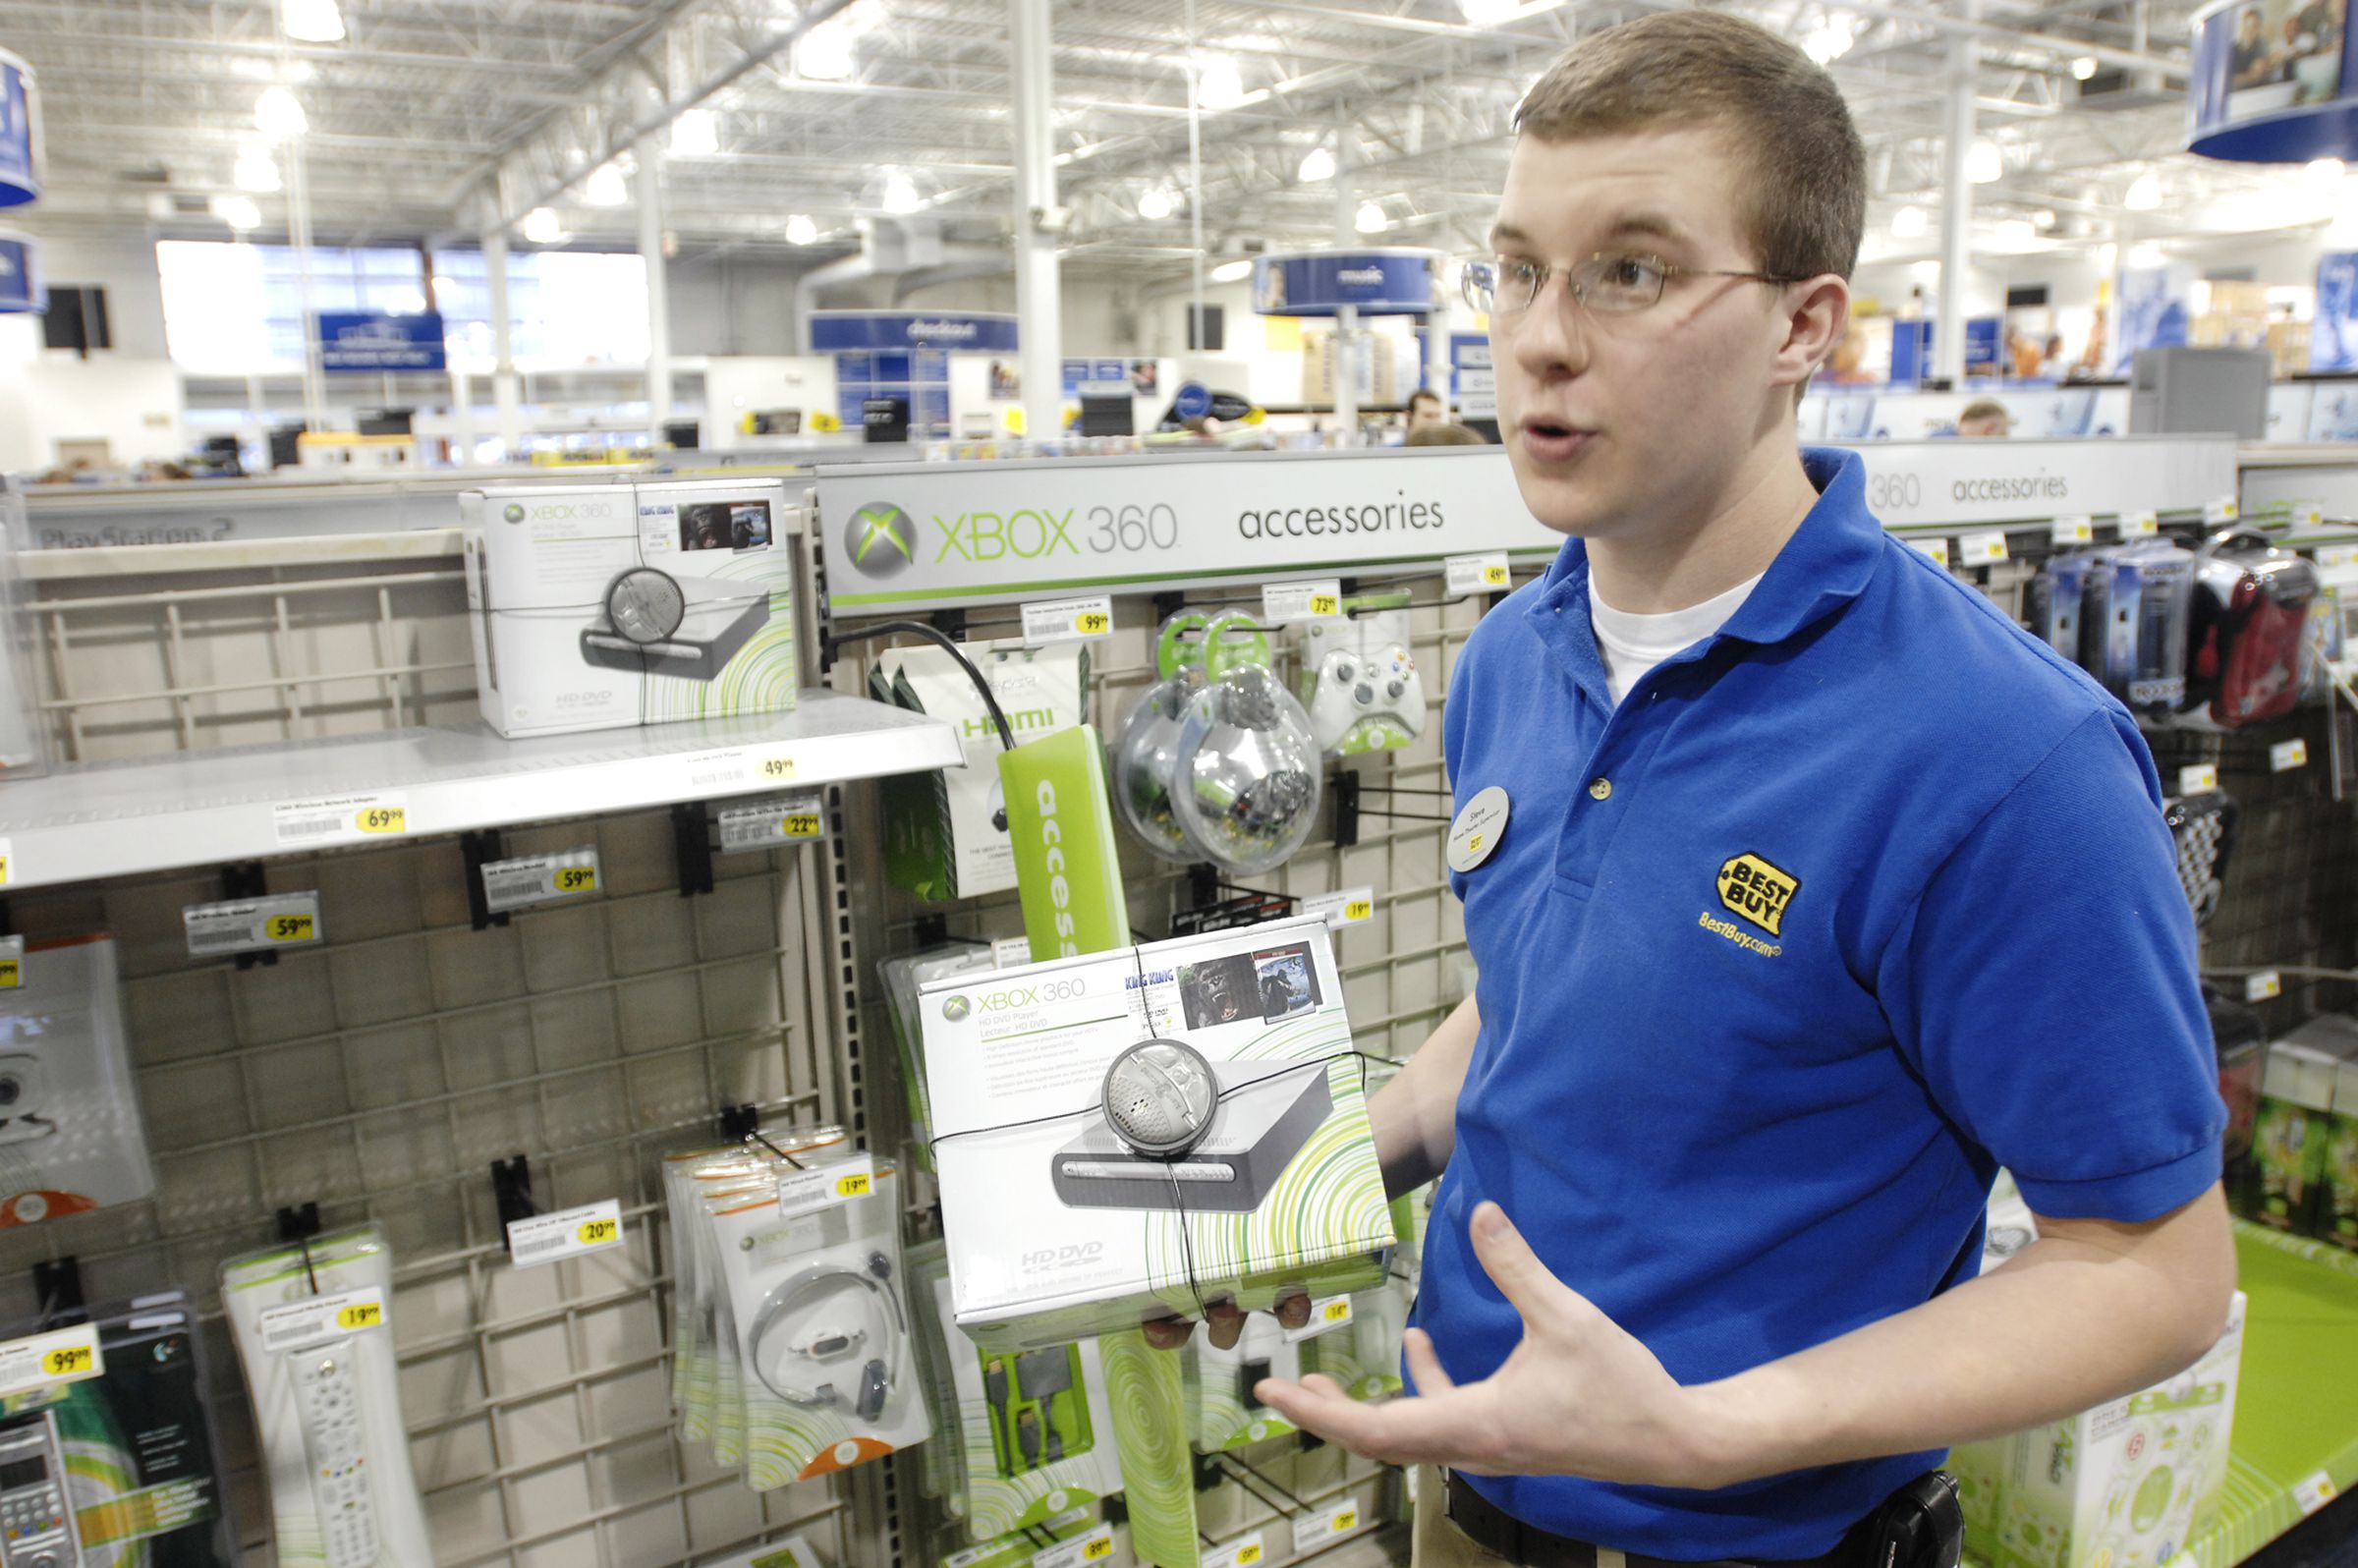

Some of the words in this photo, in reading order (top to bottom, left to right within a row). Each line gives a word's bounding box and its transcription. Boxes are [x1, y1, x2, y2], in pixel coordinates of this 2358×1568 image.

[1871, 473, 1920, 509] 360
[1952, 466, 2067, 502] accessories
[531, 504, 578, 520] XBOX
[580, 503, 611, 518] 360
[931, 508, 1080, 563] XBOX
[1088, 503, 1178, 553] 360
[1239, 489, 1444, 539] accessories
[1732, 862, 1790, 904] BEST
[1725, 882, 1779, 922] BUY
[978, 985, 1040, 1015] XBOX
[1043, 979, 1086, 1002] 360
[979, 1017, 992, 1028] HD
[994, 1013, 1011, 1025] DVD
[1013, 1010, 1039, 1023] Player
[980, 1025, 1012, 1038] Lecteur
[1015, 1021, 1030, 1033] HD
[1031, 1018, 1047, 1030] DVD
[1022, 1250, 1055, 1267] HD
[1059, 1241, 1103, 1260] DVD
